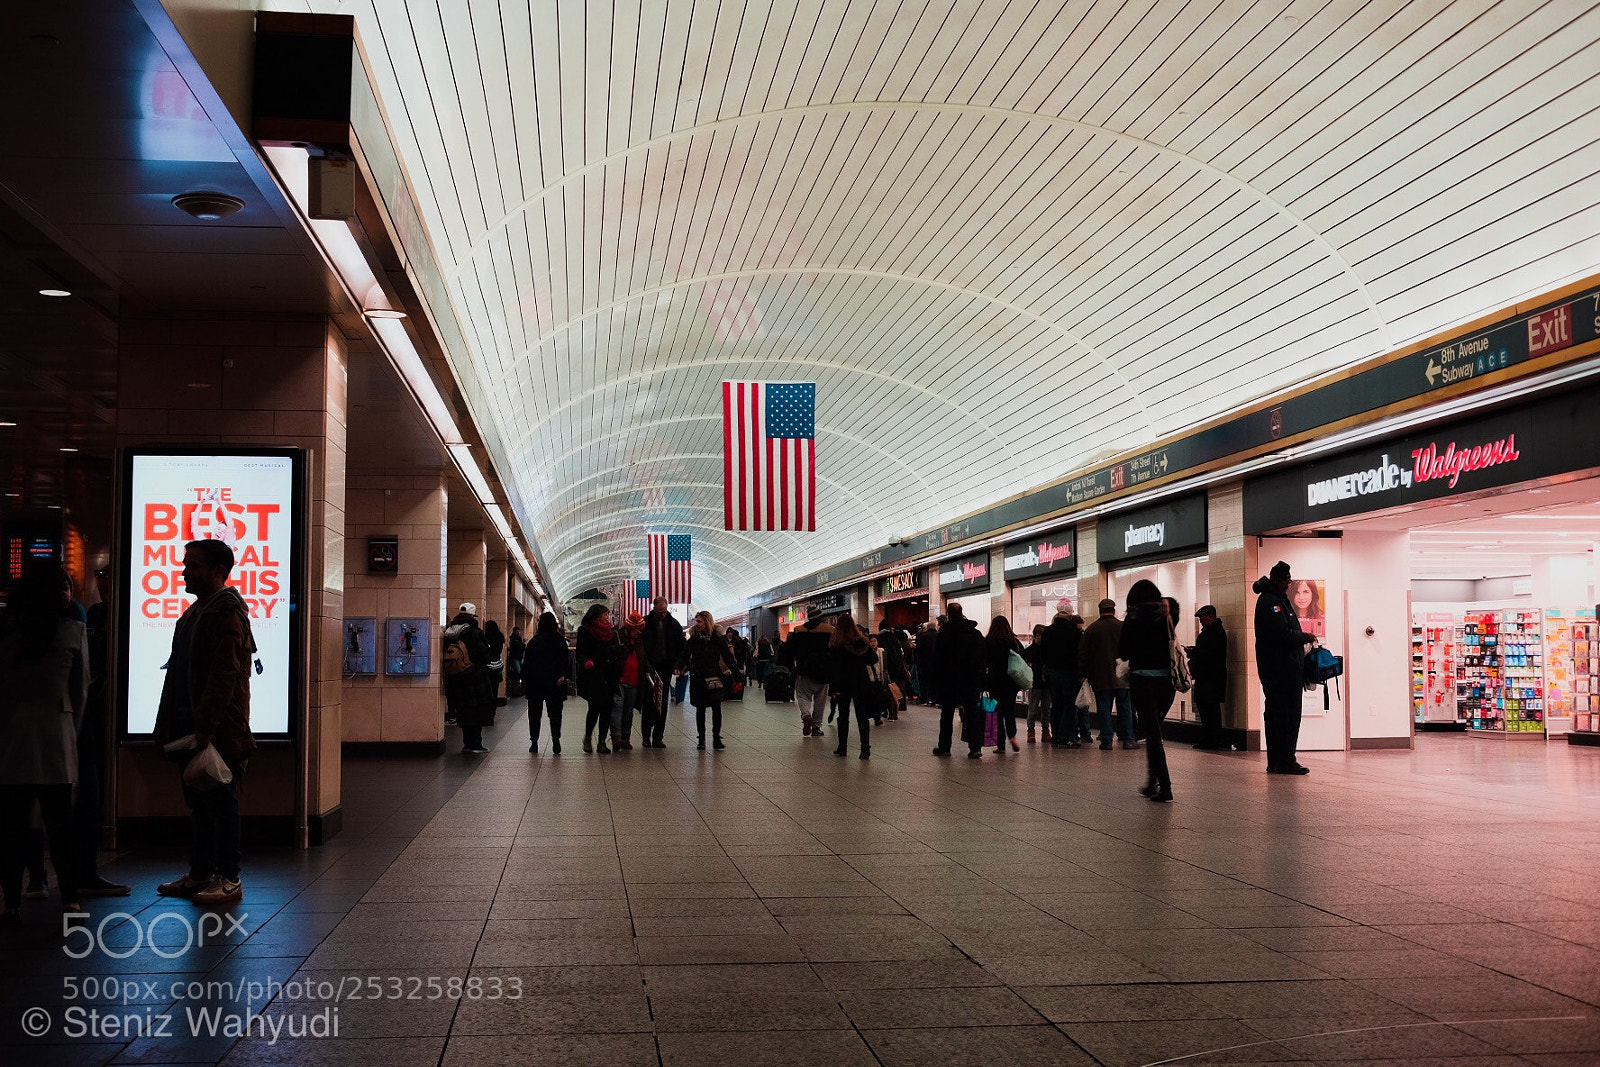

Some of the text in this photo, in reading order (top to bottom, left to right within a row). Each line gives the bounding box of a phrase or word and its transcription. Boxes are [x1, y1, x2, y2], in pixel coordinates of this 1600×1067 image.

[1529, 307, 1568, 351] Exit
[1441, 337, 1489, 364] 8th Avenue
[1442, 362, 1474, 383] Subway
[1400, 468, 1413, 488] by
[1411, 434, 1520, 488] Walgreens
[1111, 466, 1124, 488] Exit
[143, 503, 281, 541] BEST
[1124, 522, 1165, 552] pharmacy
[224, 570, 280, 595] HIS
